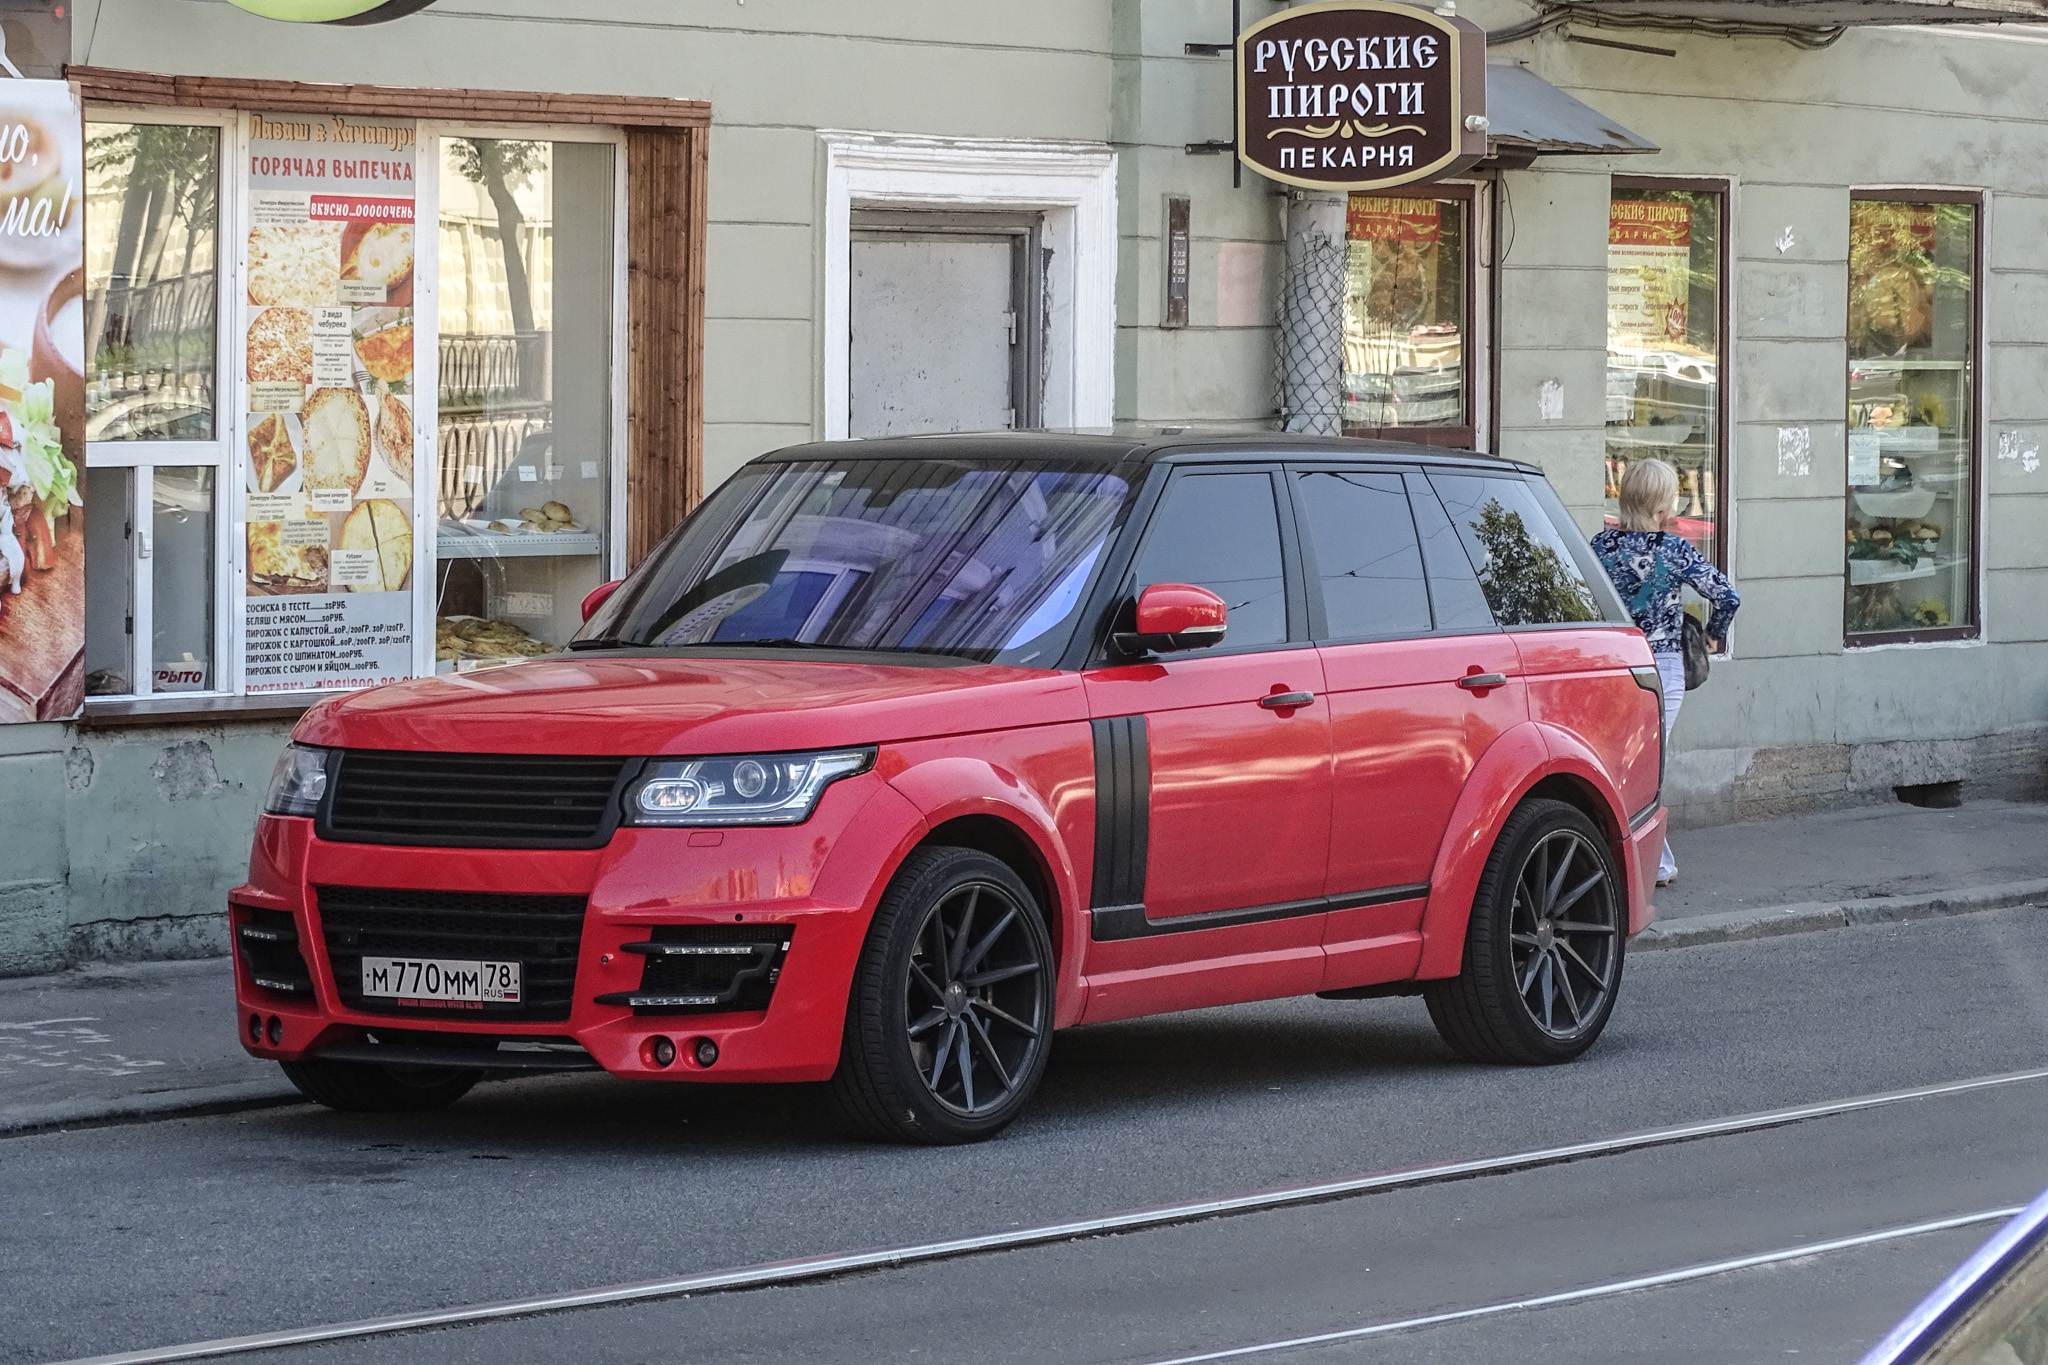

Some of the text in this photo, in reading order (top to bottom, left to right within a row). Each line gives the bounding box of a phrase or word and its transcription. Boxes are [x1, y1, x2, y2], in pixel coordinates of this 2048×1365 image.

[1254, 35, 1439, 82] РУССКИЕ
[1268, 82, 1425, 118] ПИРОГИ
[250, 114, 310, 141] Лаваш
[330, 117, 416, 151] Хачапури
[1280, 145, 1414, 169] ПЕКАРНЯ
[252, 157, 413, 181] ГОРЯЧАЯ ВЫПЕЧКА
[1648, 206, 1688, 223] ПИРОГИ
[1621, 286, 1641, 295] пироги
[322, 310, 342, 319] 3 вида
[318, 319, 347, 329] чебурека
[246, 603, 280, 613] СОСИСКА
[281, 603, 287, 611] В
[246, 616, 271, 625] БЕЛЯШ
[273, 616, 278, 624] С
[246, 628, 282, 638] ПИРОЖОК
[283, 628, 289, 636] С
[246, 641, 282, 651] ПИРОЖОК
[283, 641, 288, 649] С
[246, 653, 282, 664] ПИРОЖОК
[283, 653, 293, 661] СО
[246, 667, 282, 676] ПИРОЖОК
[283, 666, 289, 674] С
[290, 664, 316, 673] СЫРОМ
[317, 663, 323, 672] И
[485, 964, 511, 988] 78
[484, 989, 503, 998] RUS
